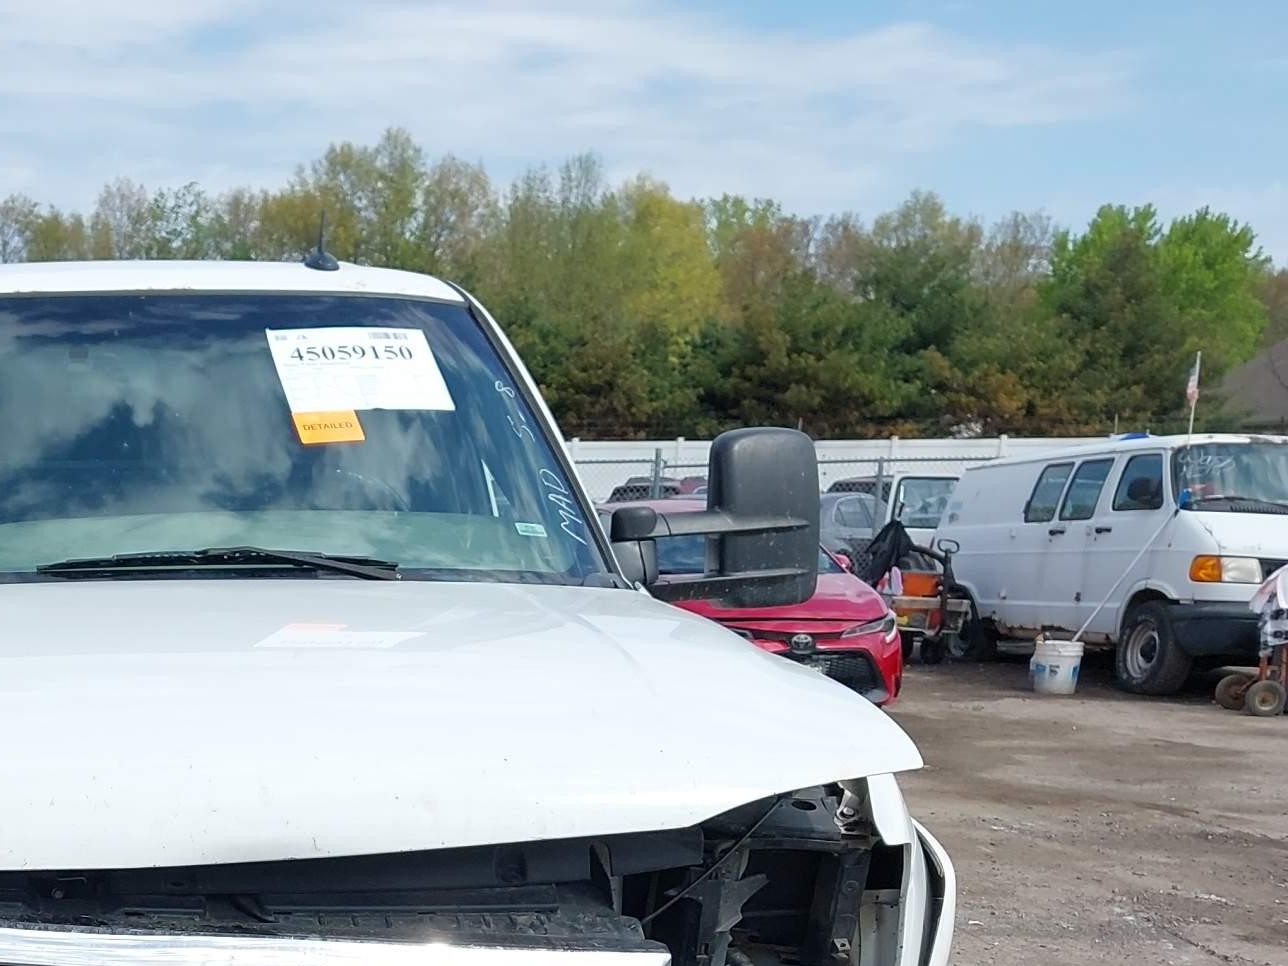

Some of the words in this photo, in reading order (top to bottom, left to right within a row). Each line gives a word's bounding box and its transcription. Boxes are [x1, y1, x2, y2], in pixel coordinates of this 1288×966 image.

[290, 345, 413, 361] 45059150
[303, 422, 353, 431] DETAILED
[539, 468, 588, 546] MAD
